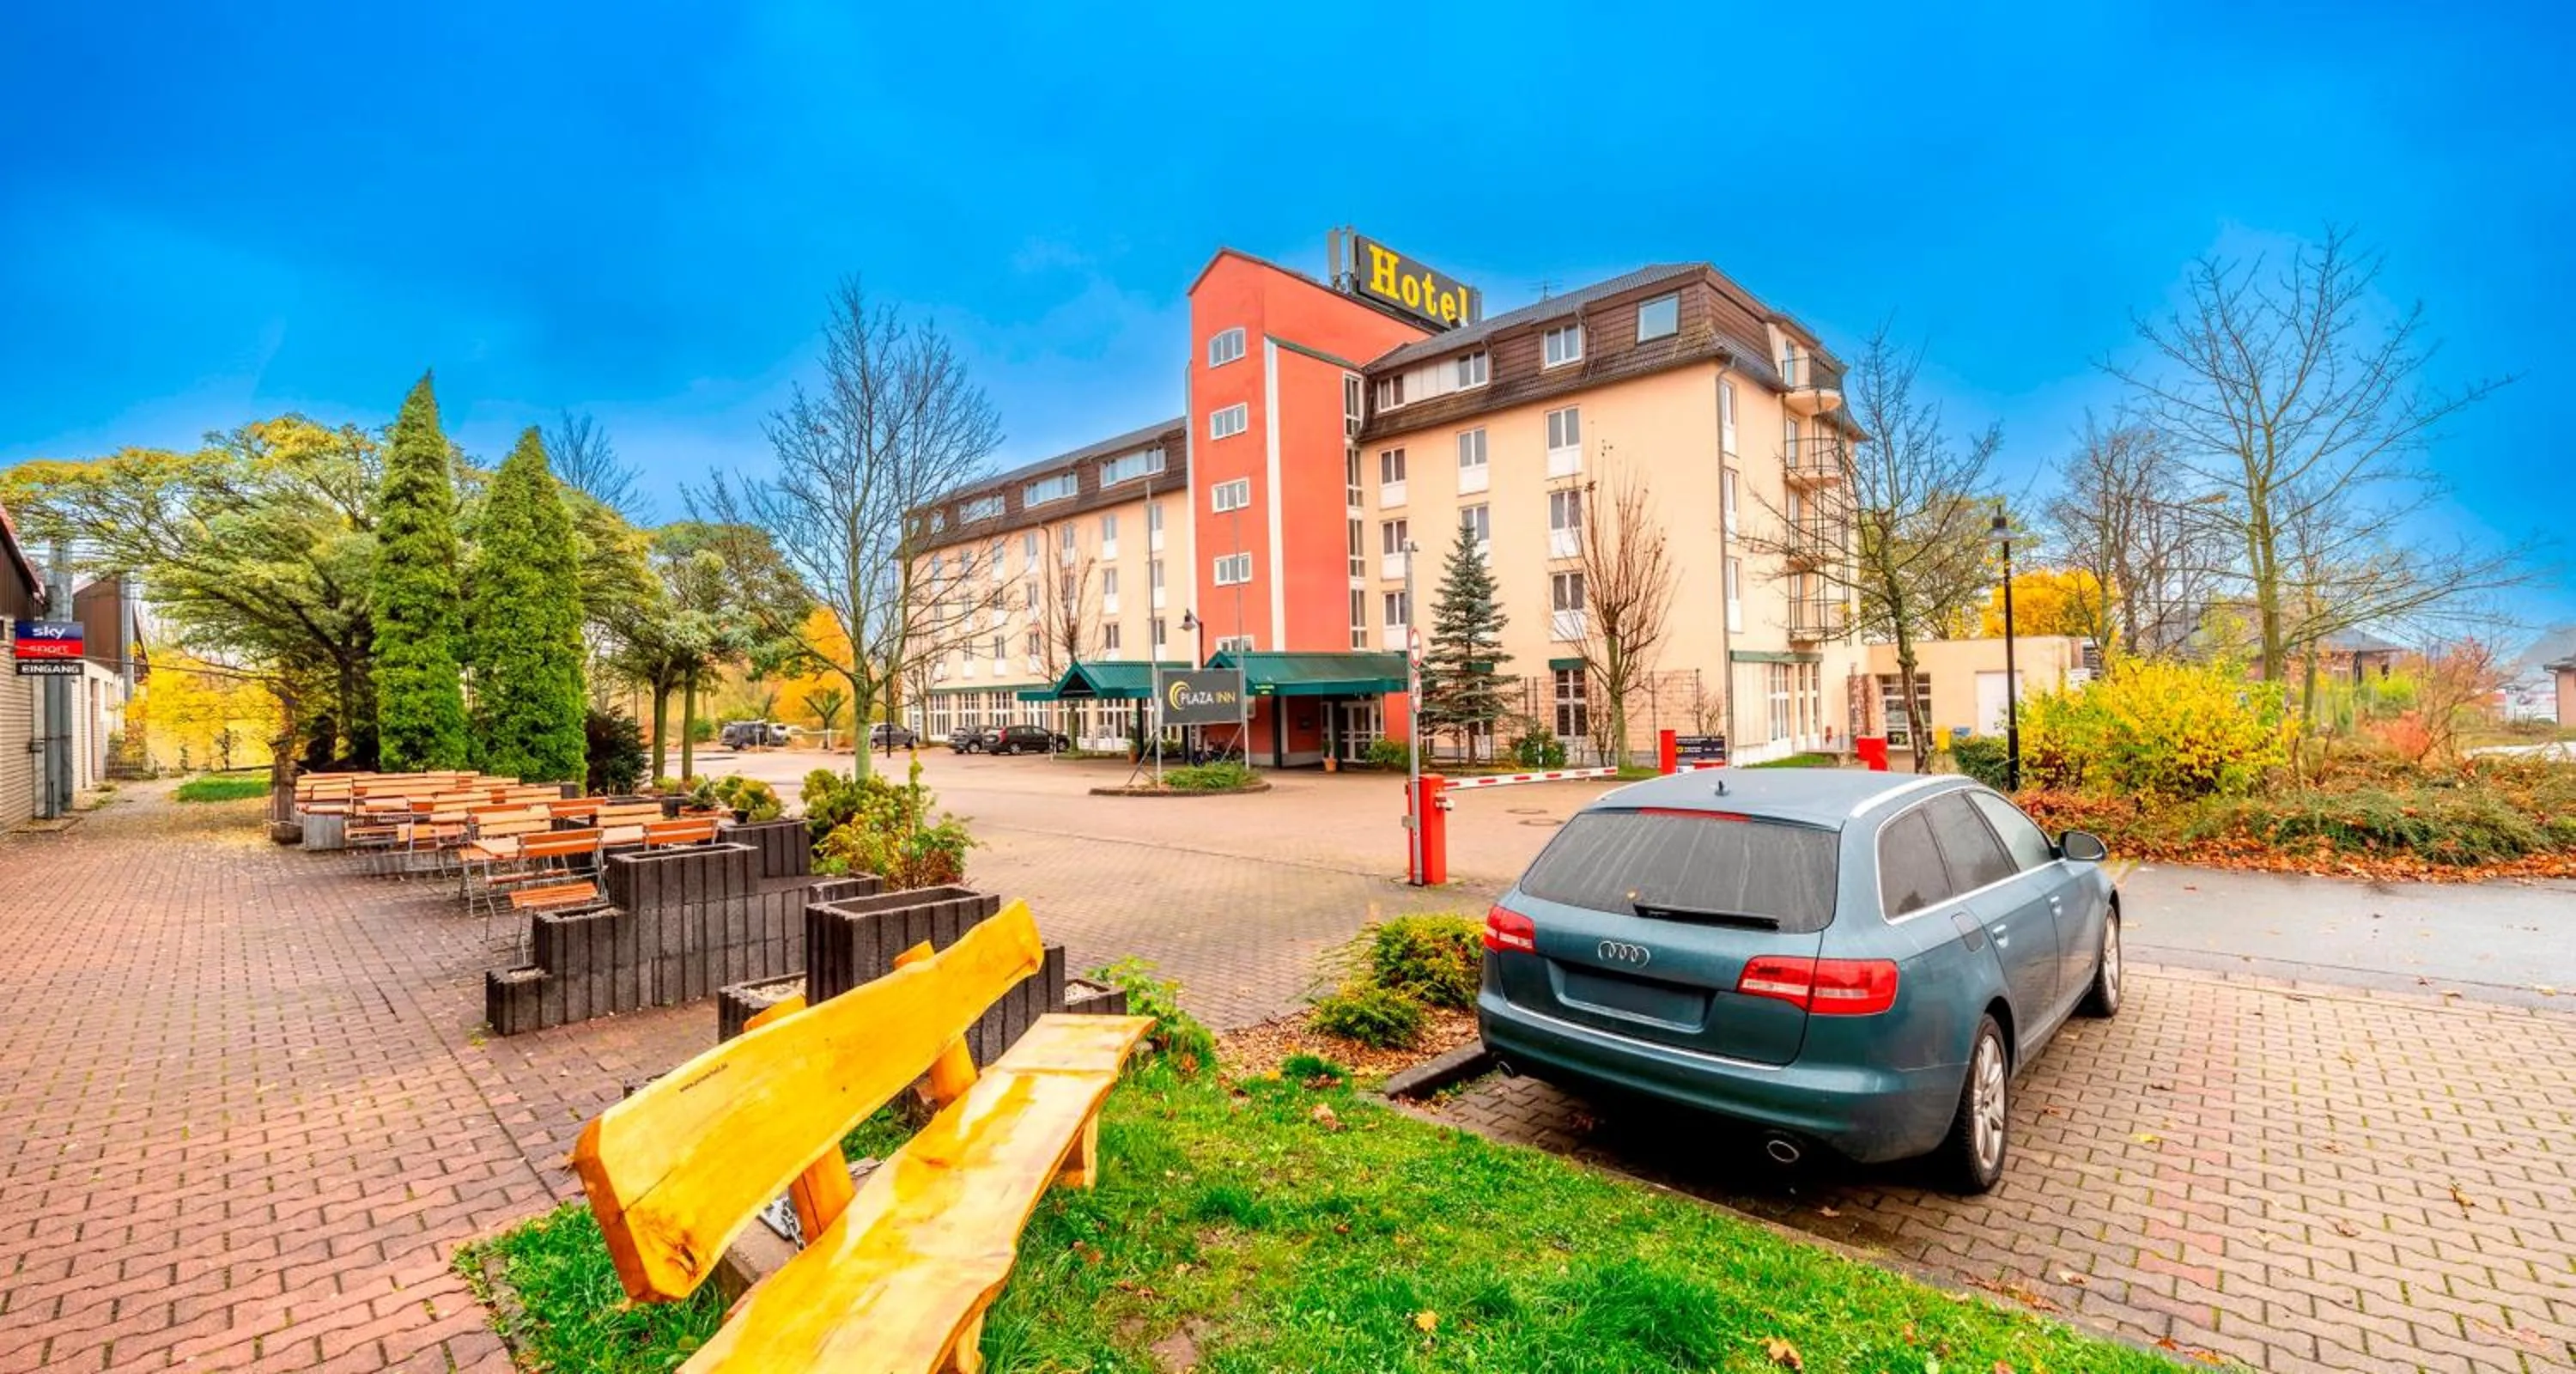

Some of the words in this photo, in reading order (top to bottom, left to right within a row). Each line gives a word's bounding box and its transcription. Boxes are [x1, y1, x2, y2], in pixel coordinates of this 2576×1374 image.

[1368, 244, 1468, 327] Hotel
[32, 625, 66, 639] sky
[21, 664, 79, 673] EINGANG
[1180, 691, 1214, 704] PLAZA
[1216, 690, 1236, 702] INN
